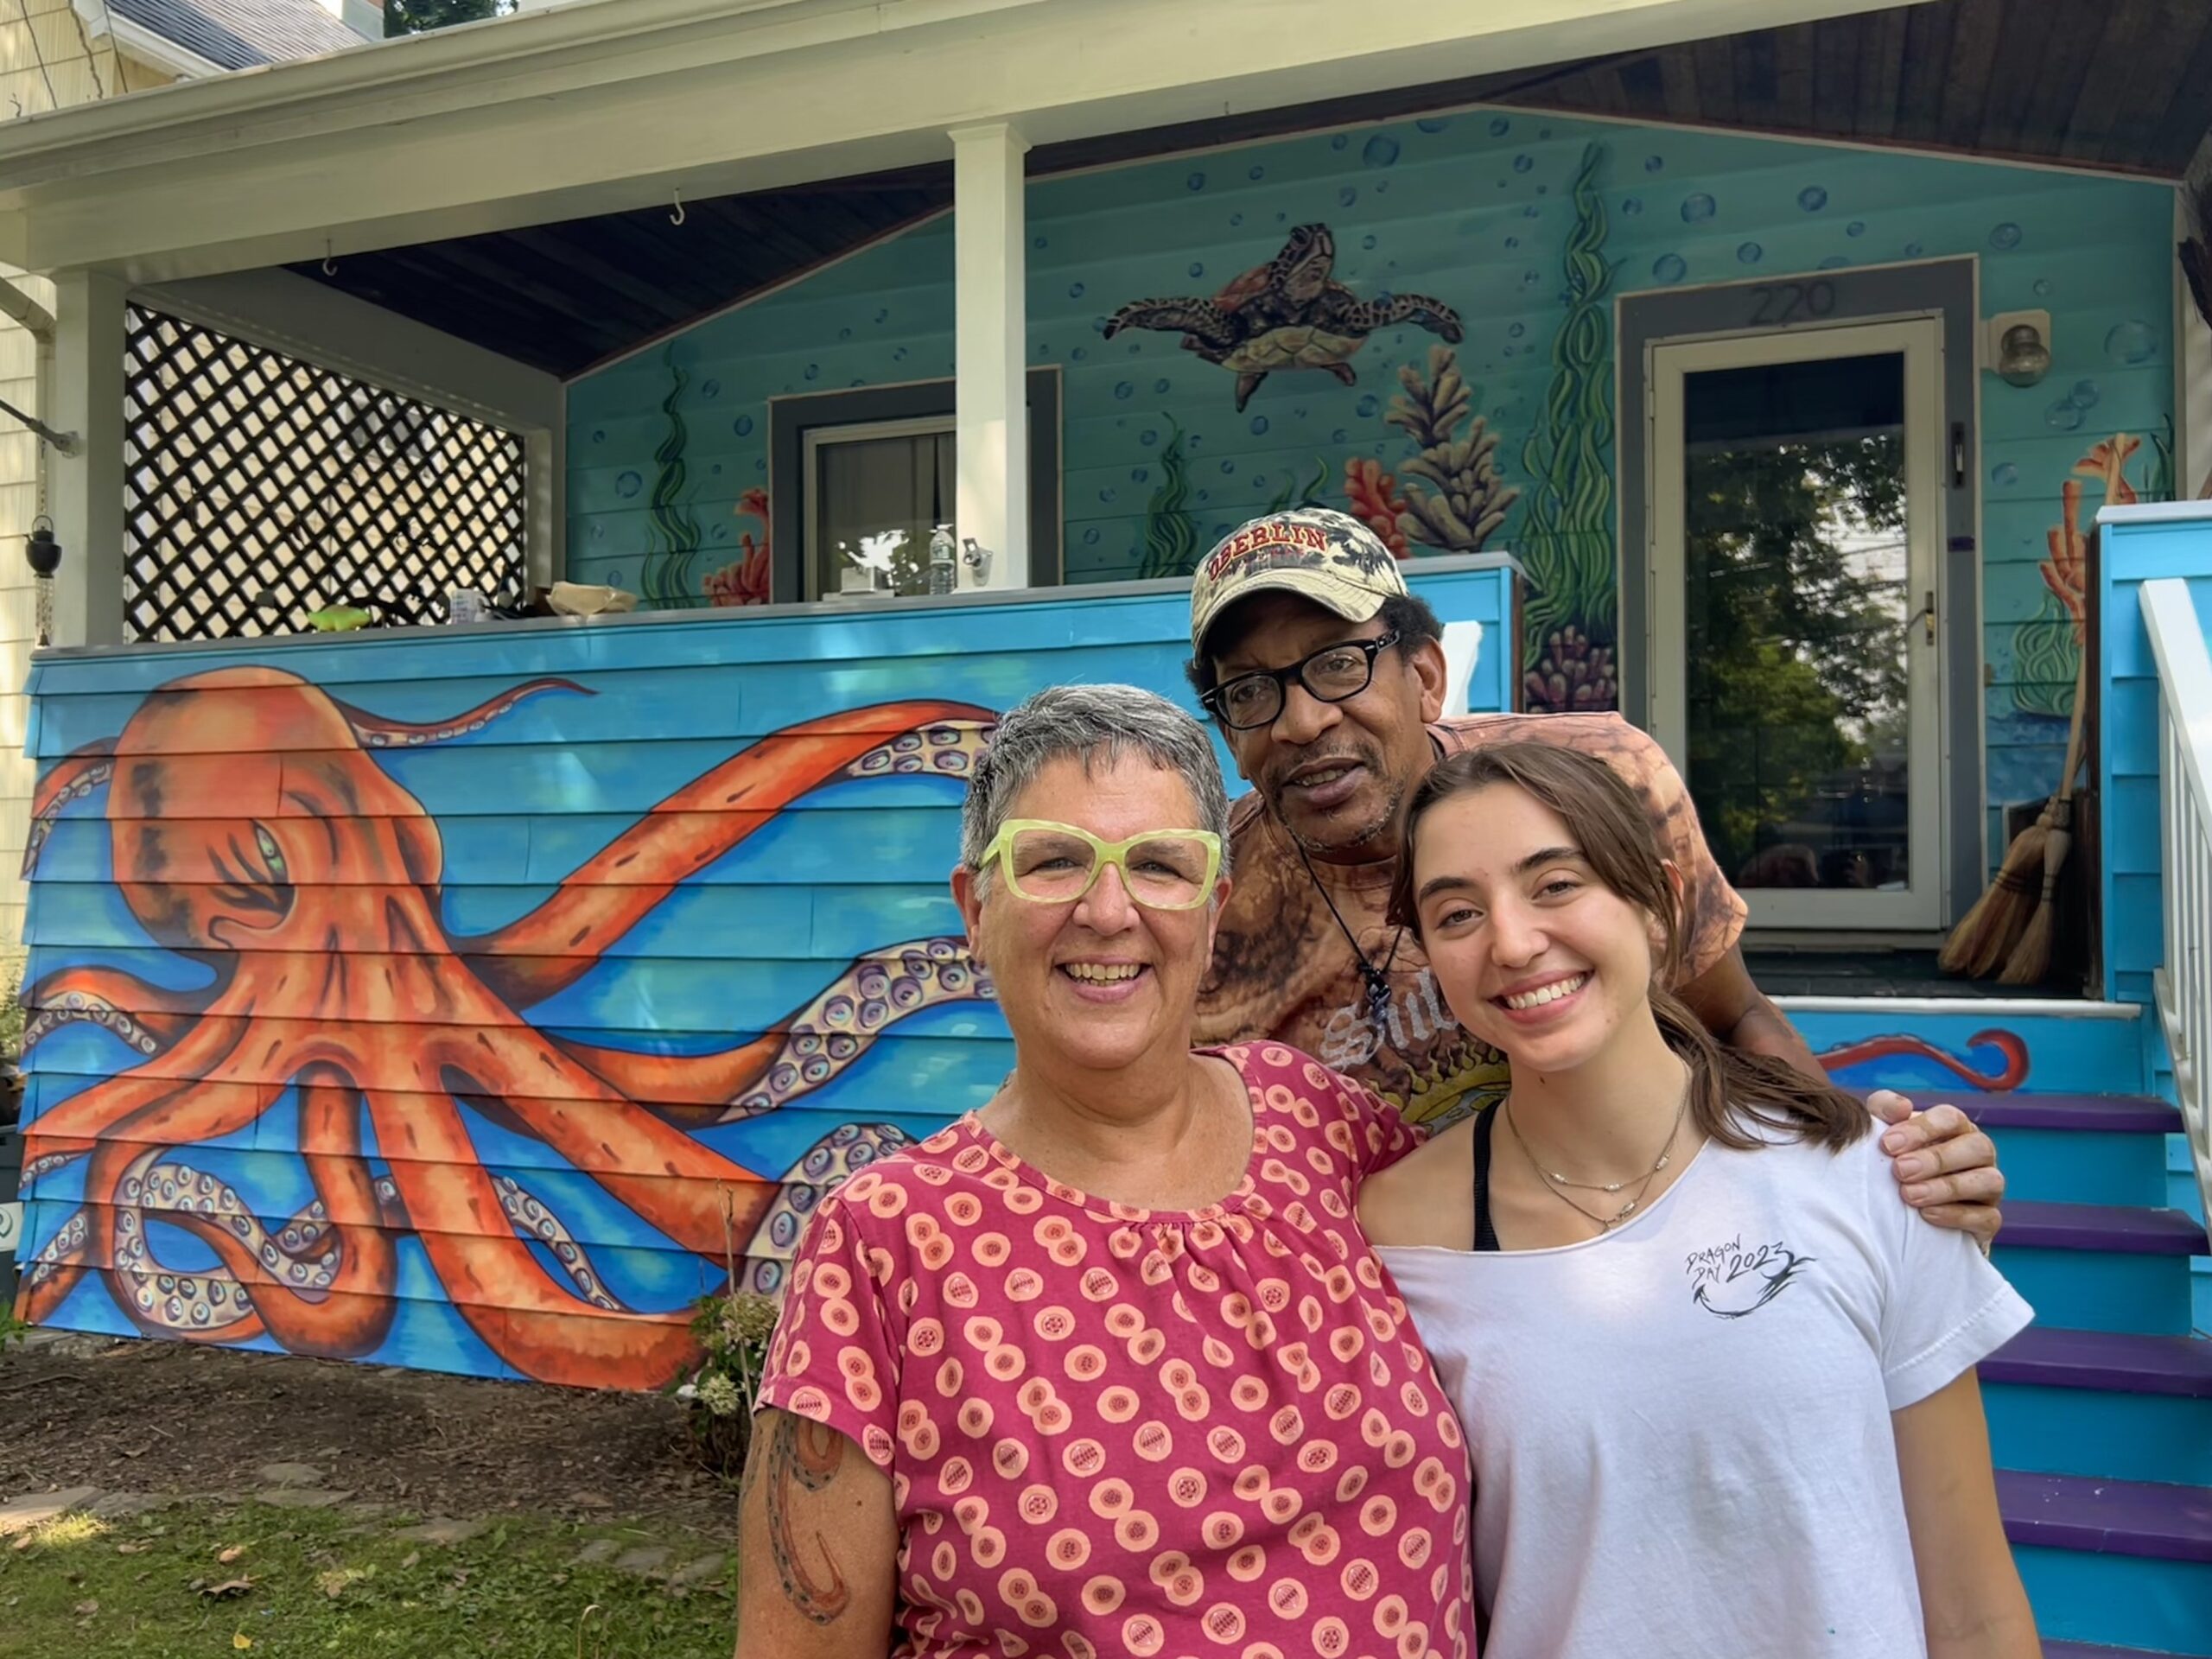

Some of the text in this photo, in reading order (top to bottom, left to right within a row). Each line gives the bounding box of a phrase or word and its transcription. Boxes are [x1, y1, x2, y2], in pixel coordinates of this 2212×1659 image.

[1749, 280, 1836, 327] 220
[1208, 522, 1328, 582] OBERLIN
[1686, 1233, 1741, 1275] DRAGON
[1691, 1241, 1795, 1290] DAY 2023
